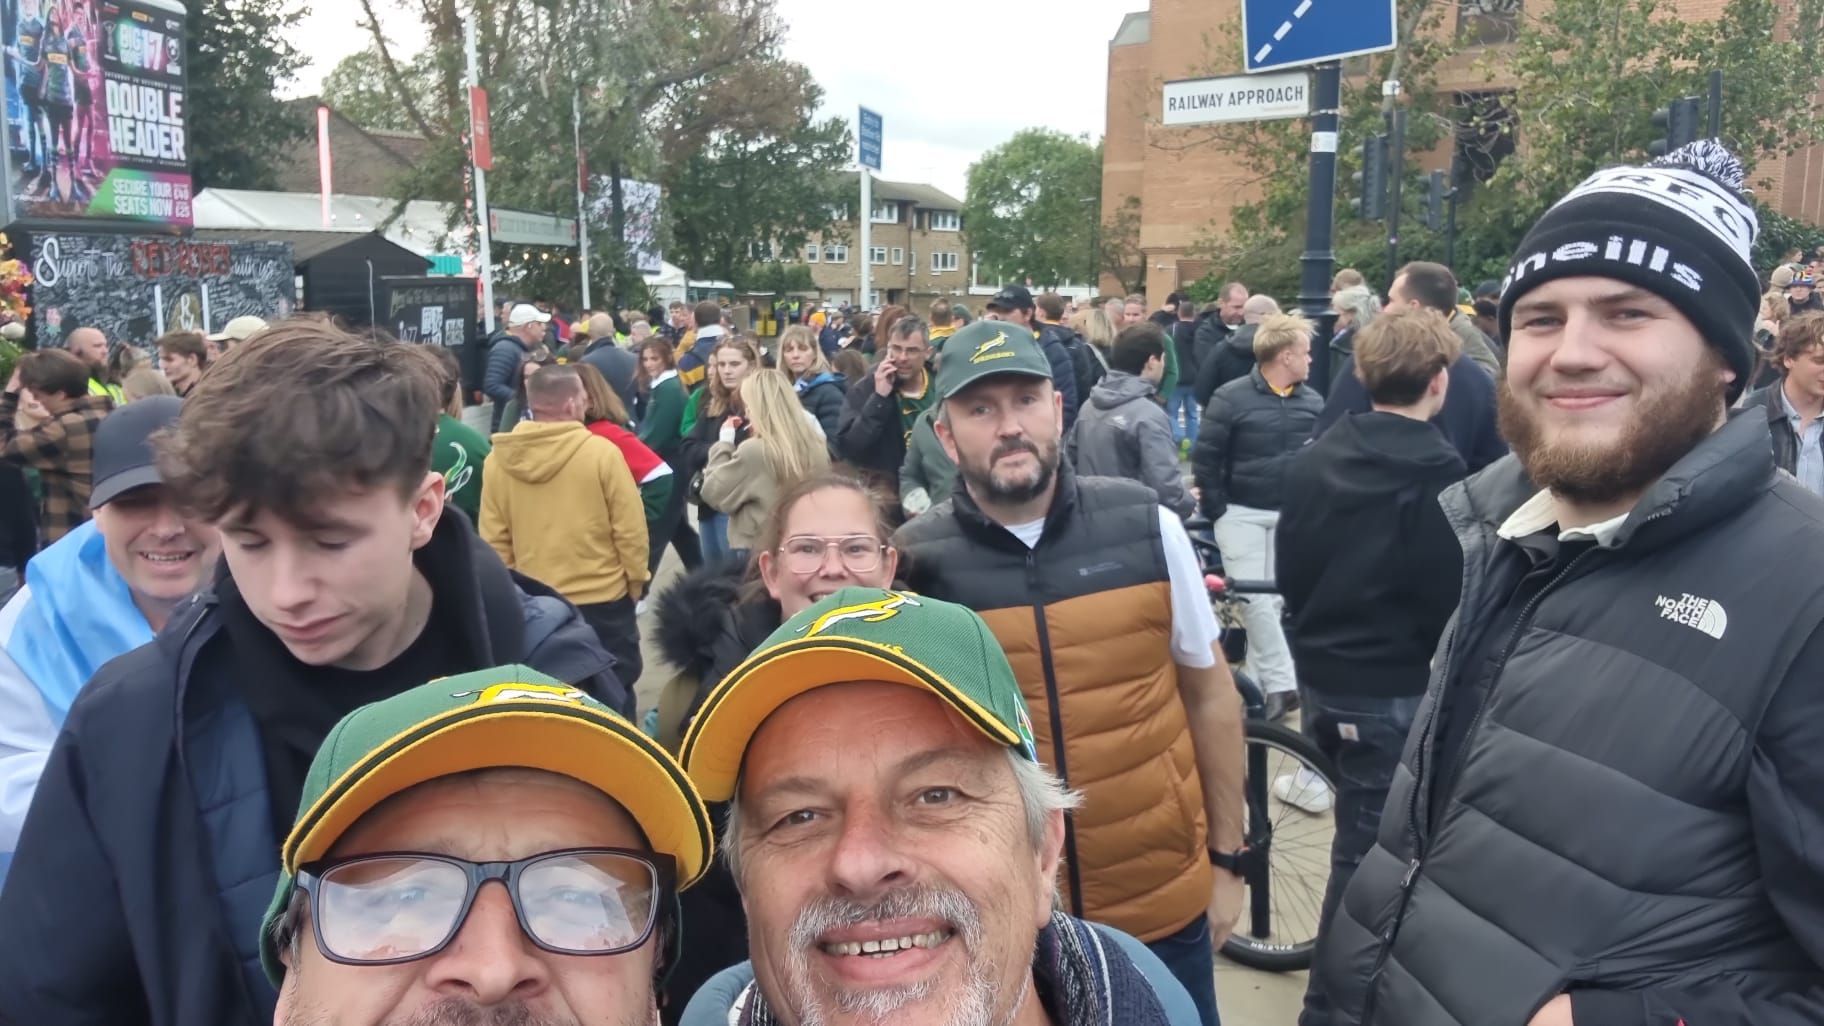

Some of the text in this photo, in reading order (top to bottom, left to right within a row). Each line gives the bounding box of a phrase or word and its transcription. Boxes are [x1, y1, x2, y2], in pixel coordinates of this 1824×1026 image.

[120, 24, 164, 71] BIG 17
[105, 79, 184, 126] DOUBLE
[1169, 85, 1304, 112] RAILWAY APPROACH
[109, 117, 187, 161] HEADER
[112, 179, 148, 196] SECURE
[148, 181, 172, 198] YOUR
[114, 195, 148, 216] SEATS
[149, 197, 173, 217] NOW
[1583, 174, 1740, 239] RFC
[36, 237, 100, 288] Support
[1655, 594, 1706, 619] NORTH
[1681, 592, 1709, 608] THE
[1660, 607, 1700, 628] FACE
